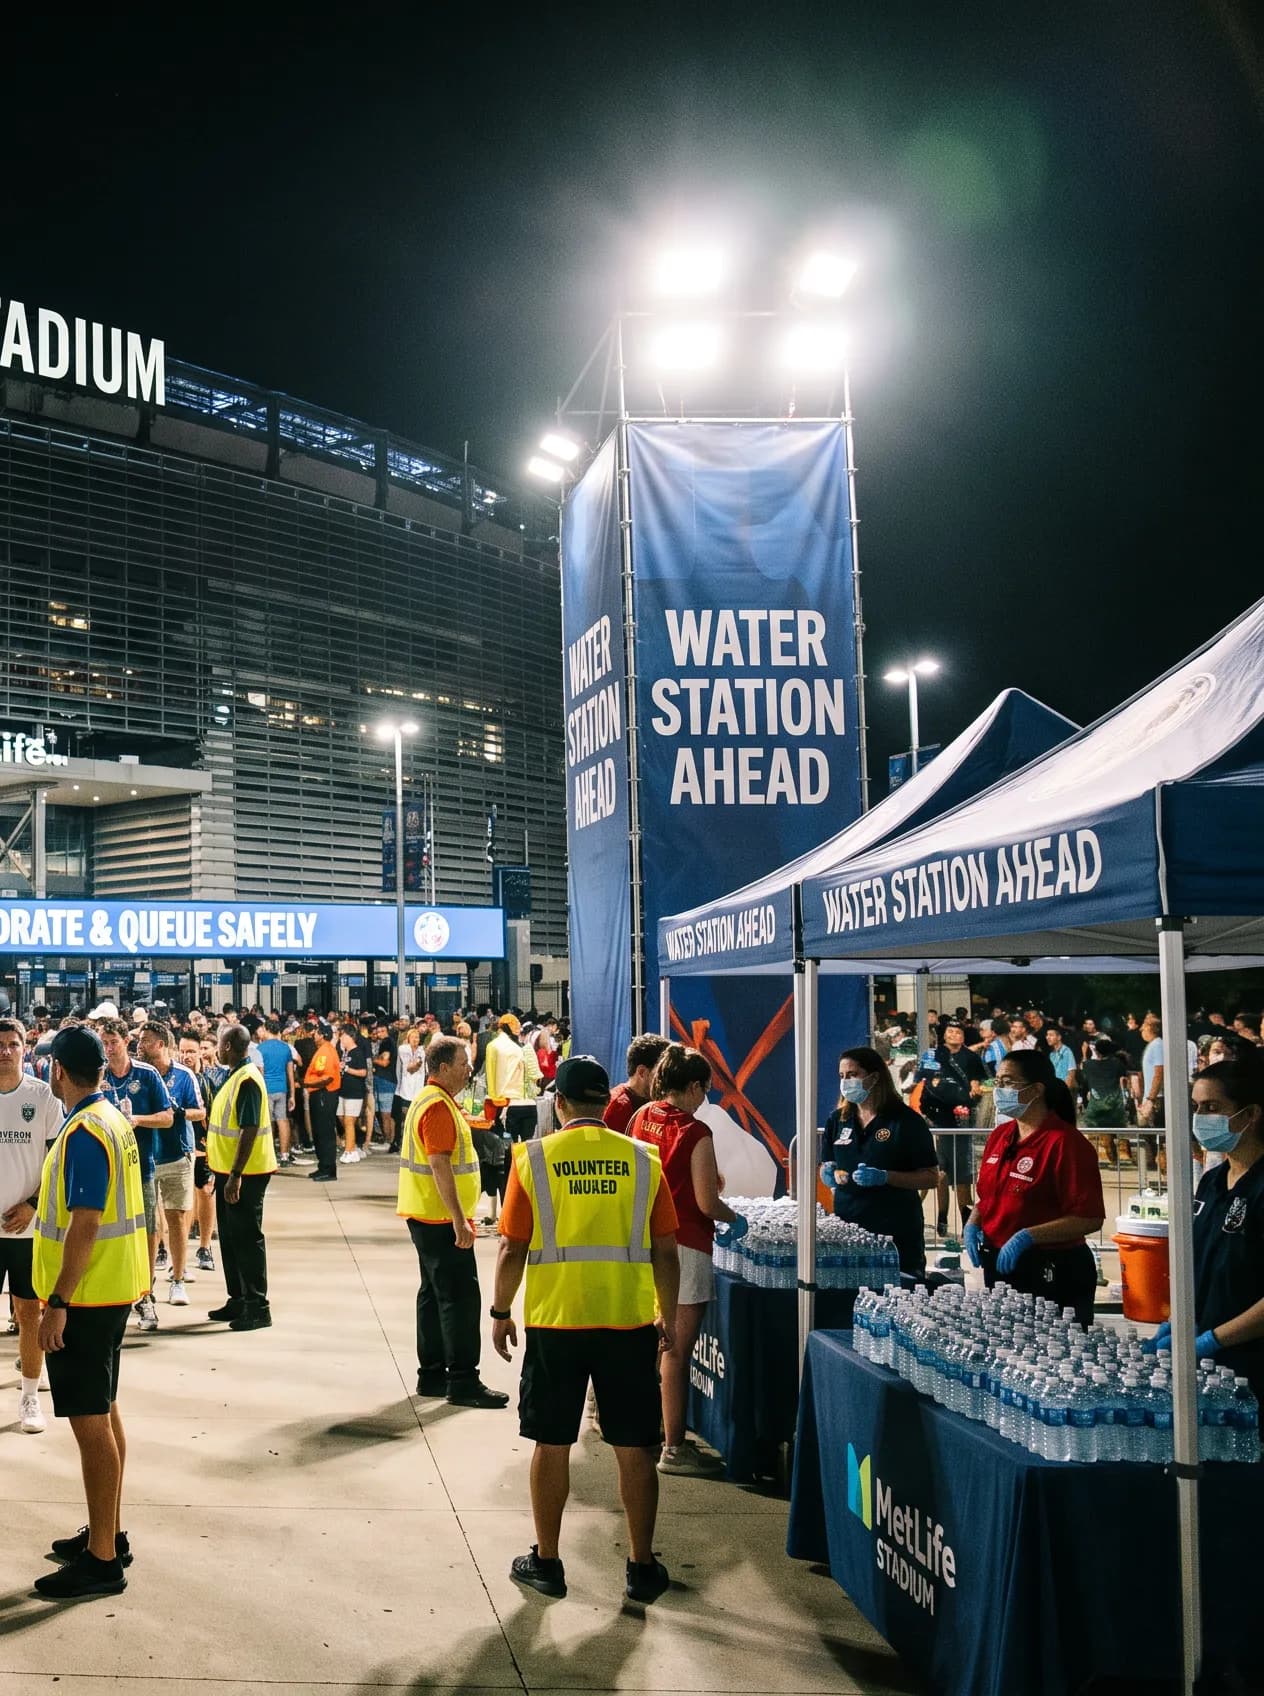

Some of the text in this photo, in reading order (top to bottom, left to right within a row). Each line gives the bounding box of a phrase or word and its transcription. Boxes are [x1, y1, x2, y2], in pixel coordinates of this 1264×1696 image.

[569, 614, 613, 699] WATER
[665, 609, 828, 666] WATER
[567, 681, 621, 767] STATION
[652, 678, 845, 736] STATION
[575, 757, 616, 831] AHEAD
[670, 747, 829, 804] AHEAD
[822, 829, 1103, 935] WATER STATION AHEAD
[89, 909, 113, 947] &
[118, 910, 211, 953] QUEUE
[218, 912, 318, 949] SAFELY
[665, 904, 776, 961] WATER STATION AHEAD
[692, 1332, 726, 1379] etLife
[876, 1477, 957, 1588] MetLife
[876, 1537, 935, 1616] STADIUM
